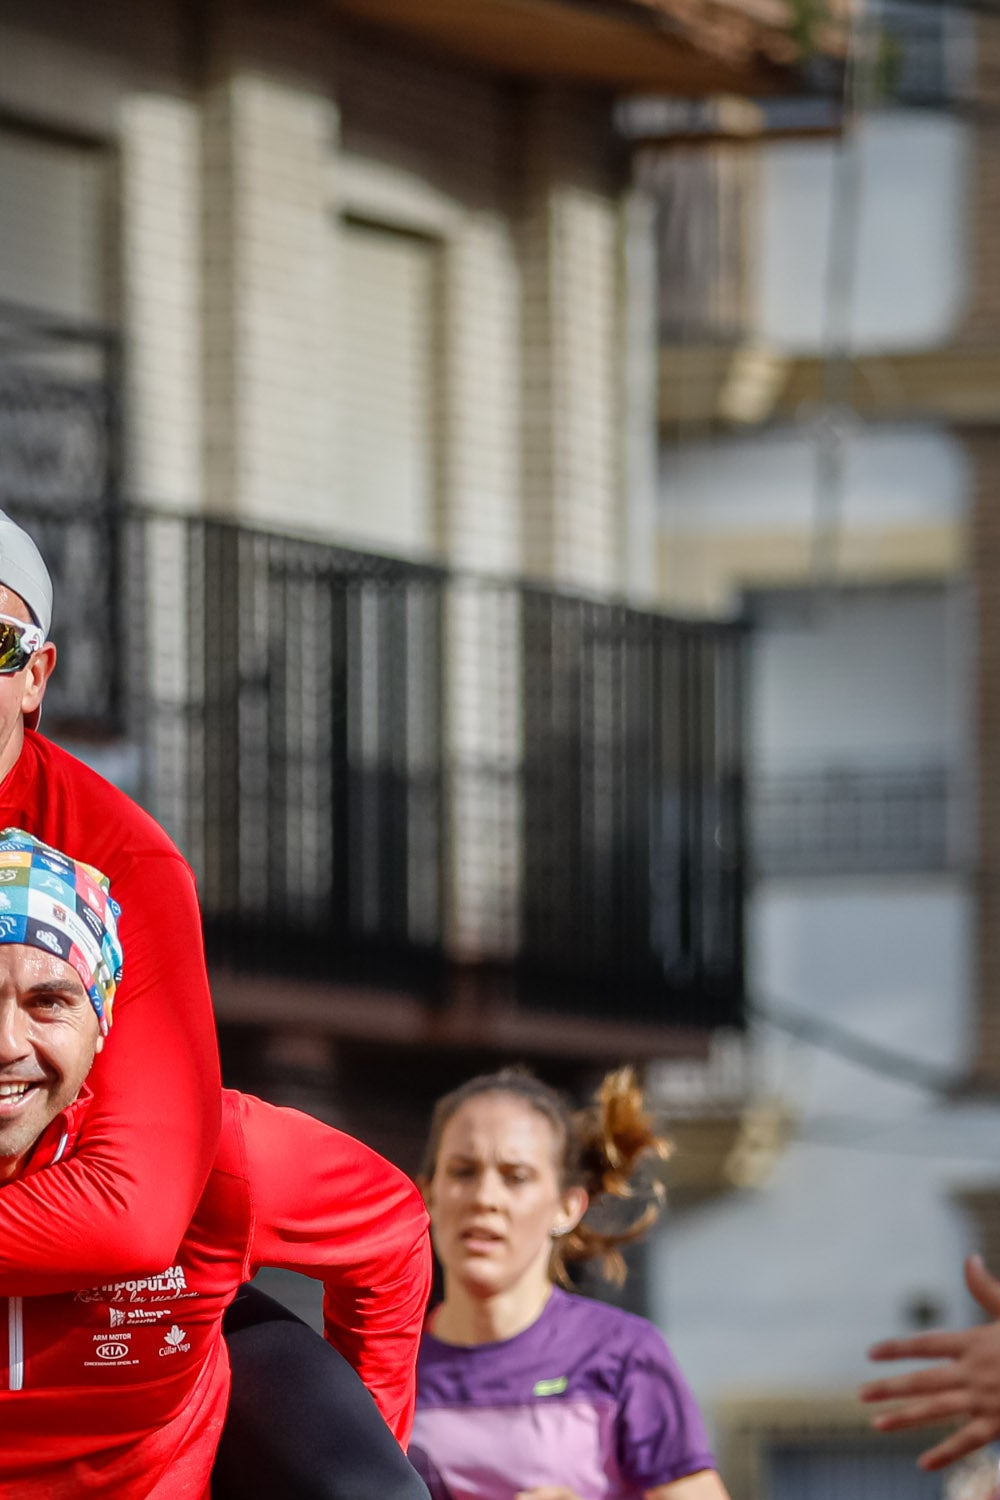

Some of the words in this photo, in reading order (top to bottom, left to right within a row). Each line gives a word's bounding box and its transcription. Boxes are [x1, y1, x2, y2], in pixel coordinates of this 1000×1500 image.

[128, 1309, 171, 1319] olimpo
[93, 1334, 108, 1342] ARM
[109, 1333, 131, 1341] MOTOR
[101, 1346, 123, 1356] KIA
[176, 1343, 191, 1353] Vega
